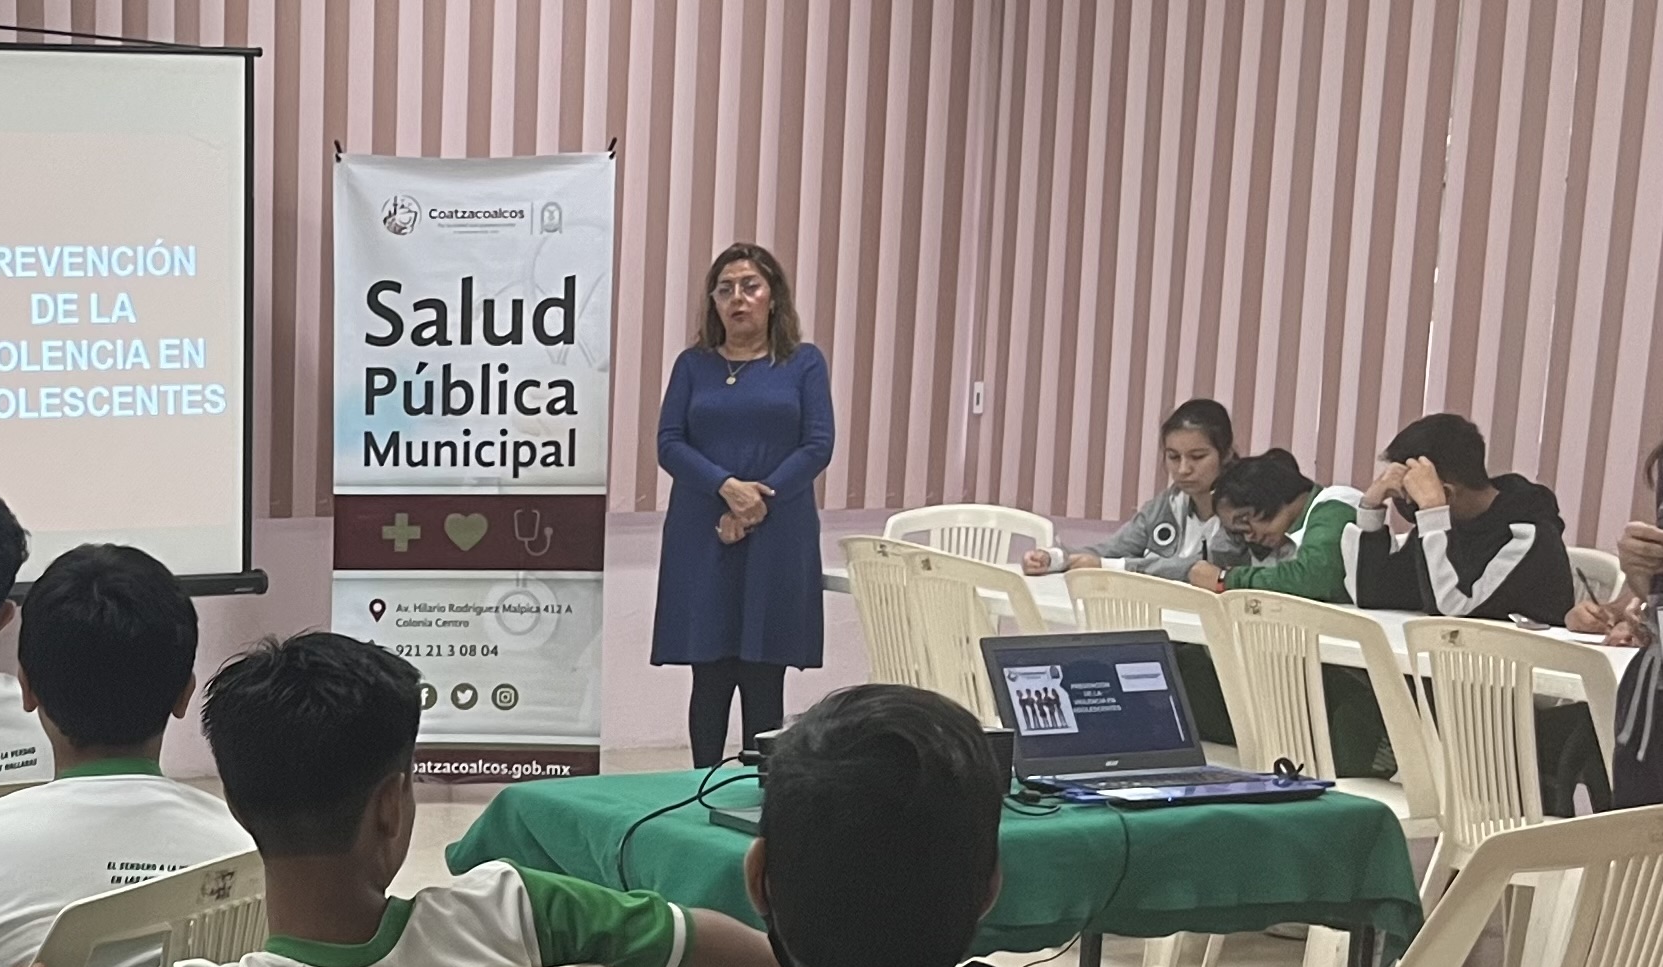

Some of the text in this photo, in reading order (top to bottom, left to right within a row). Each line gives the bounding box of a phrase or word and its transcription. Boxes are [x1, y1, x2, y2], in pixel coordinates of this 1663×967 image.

[428, 207, 525, 219] Coatzacoalcos
[30, 292, 137, 325] DE LA
[364, 275, 577, 347] Salud
[158, 337, 206, 370] EN
[364, 361, 578, 417] Pública
[363, 427, 577, 479] Municipal
[543, 604, 562, 614] 412
[564, 604, 573, 614] A
[395, 644, 499, 657] 921 21 3 08 04
[107, 861, 117, 870] EL
[159, 863, 165, 871] A
